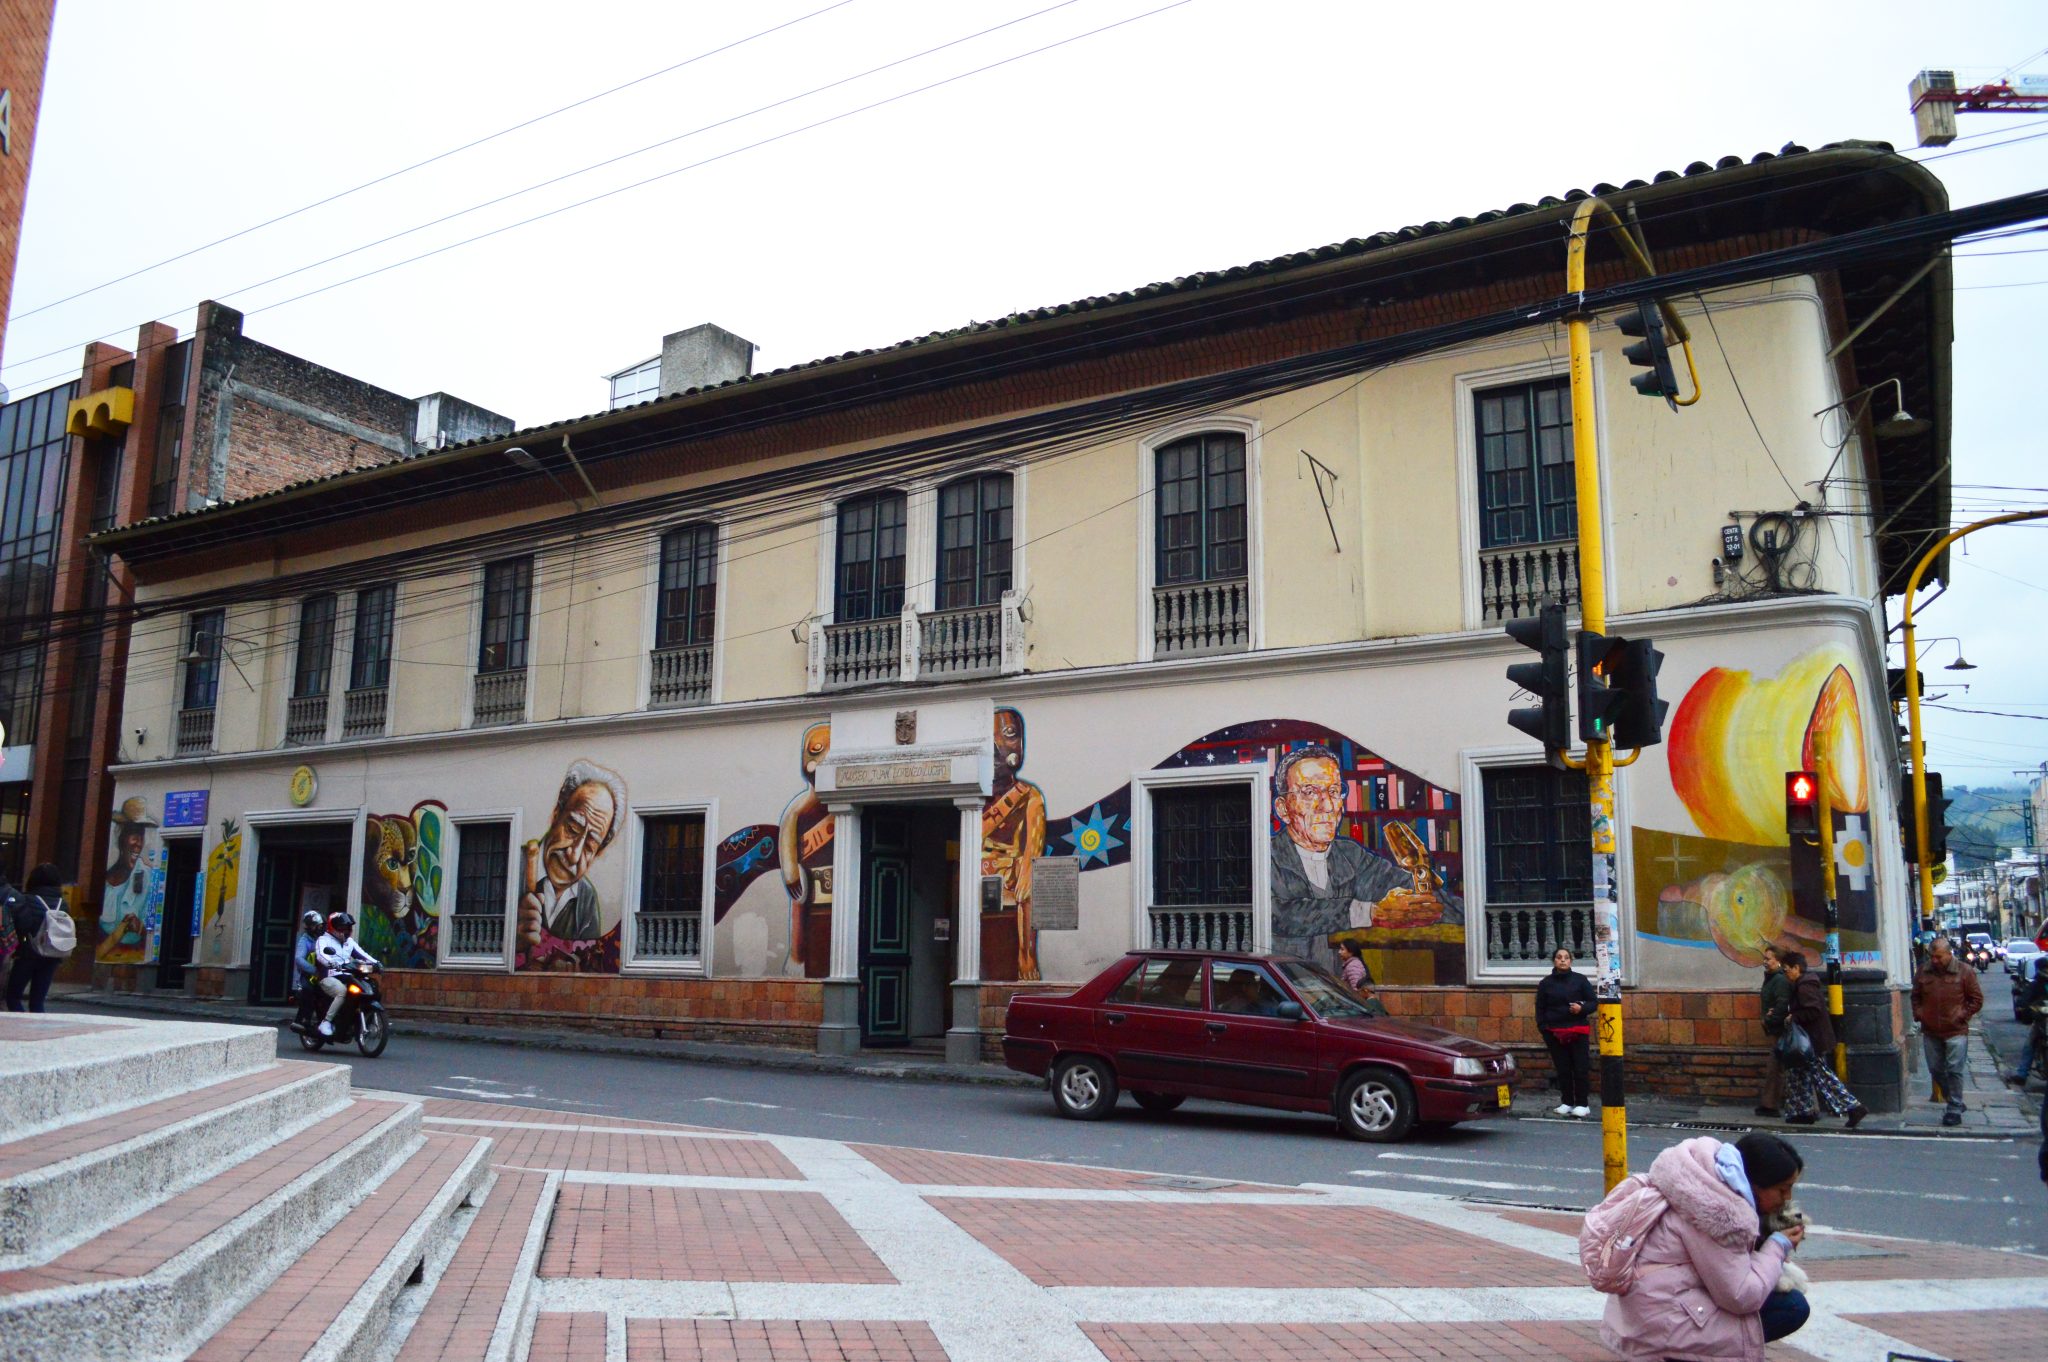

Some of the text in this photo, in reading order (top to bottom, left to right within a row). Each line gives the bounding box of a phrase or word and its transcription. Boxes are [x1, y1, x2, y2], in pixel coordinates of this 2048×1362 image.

[841, 770, 868, 782] MUSEO
[871, 768, 890, 781] JUAN
[893, 765, 922, 779] LORENZO
[2024, 801, 2033, 847] HOTEL
